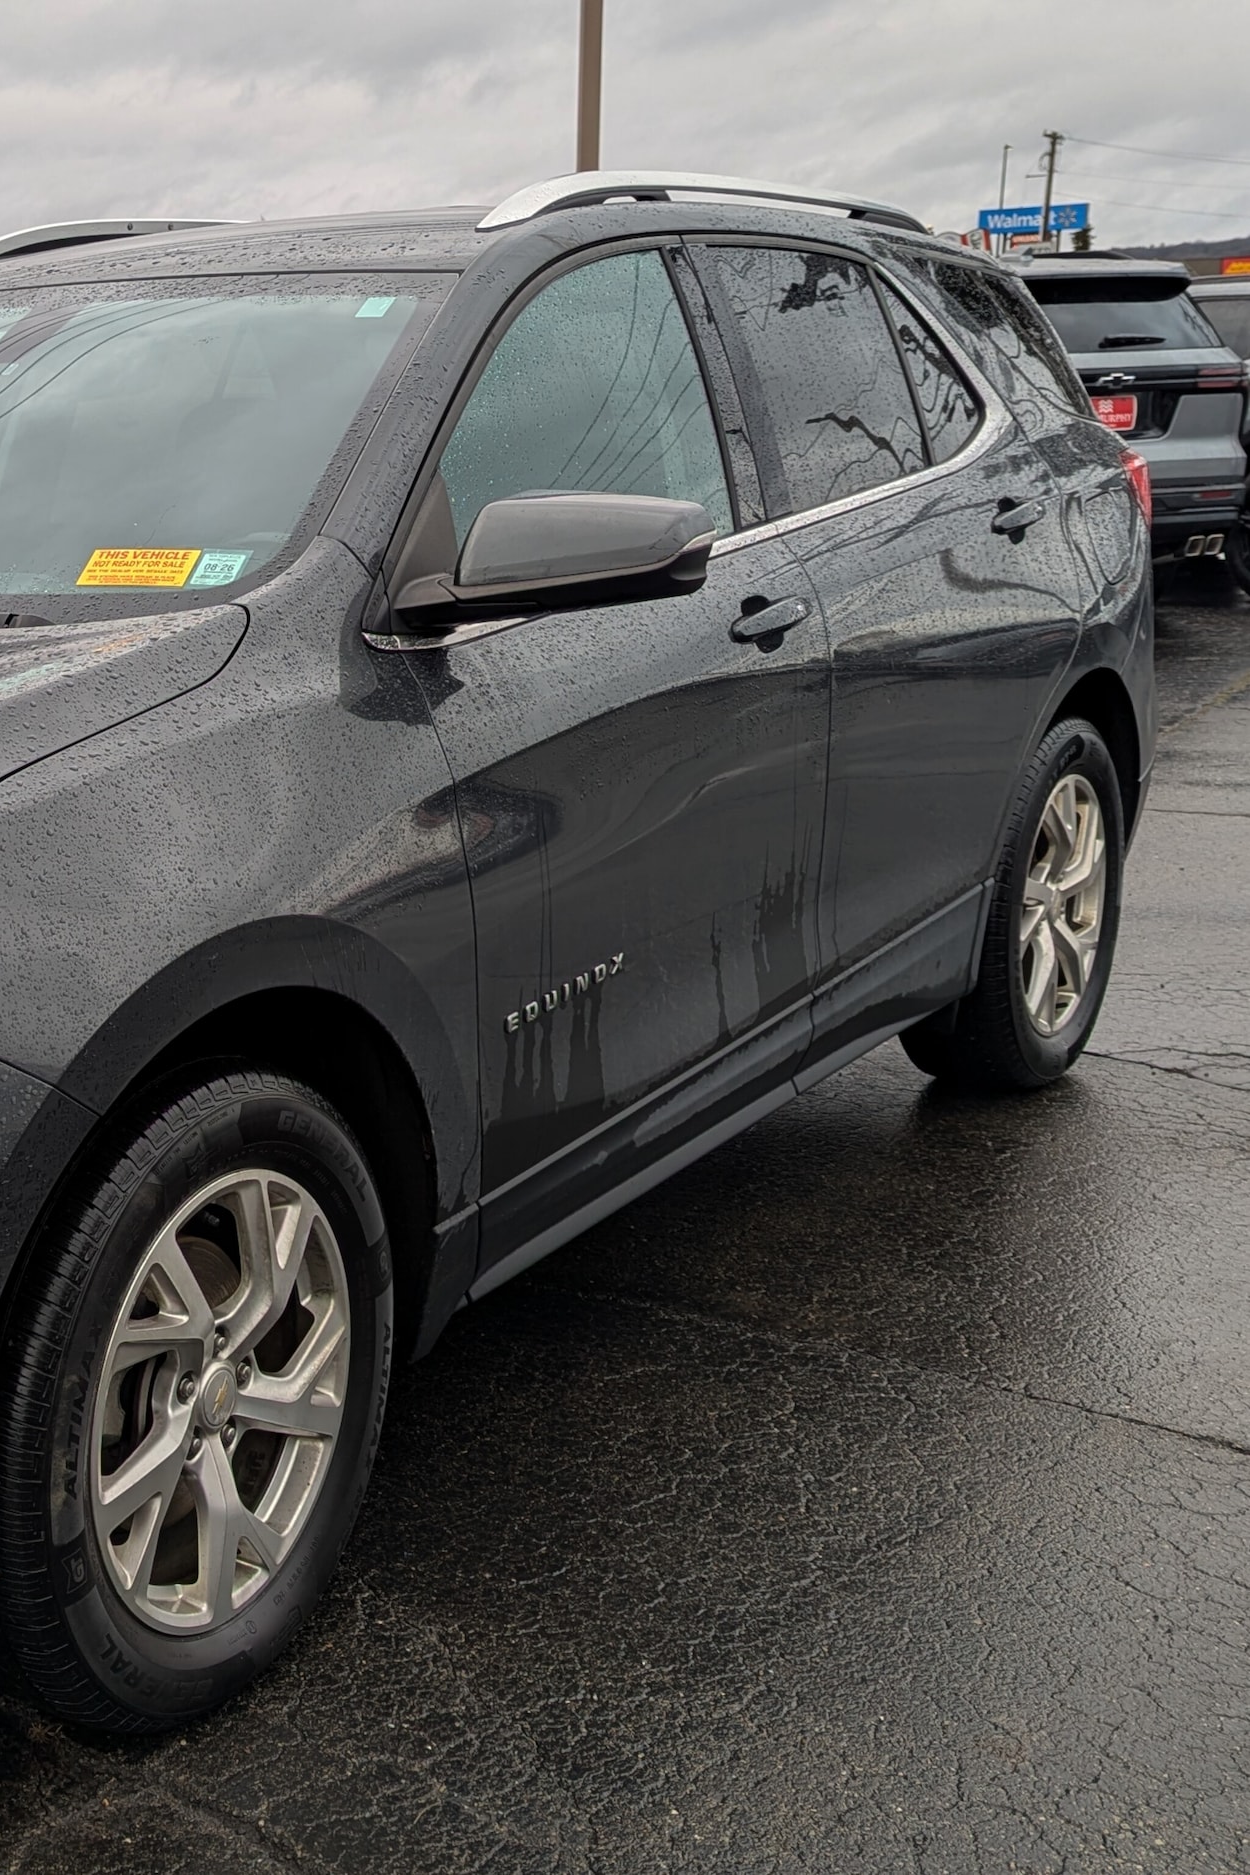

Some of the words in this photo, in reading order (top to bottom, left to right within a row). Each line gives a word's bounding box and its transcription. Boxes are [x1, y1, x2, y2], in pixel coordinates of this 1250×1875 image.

[986, 210, 1057, 230] Walmat
[92, 560, 111, 568] NOT
[111, 560, 141, 568] READY
[141, 560, 161, 568] FOR
[161, 560, 186, 569] SALE
[97, 550, 130, 560] THIS
[132, 550, 192, 560] VEHICLE
[505, 952, 624, 1034] EQUINOX
[277, 1108, 369, 1204] GENERAL
